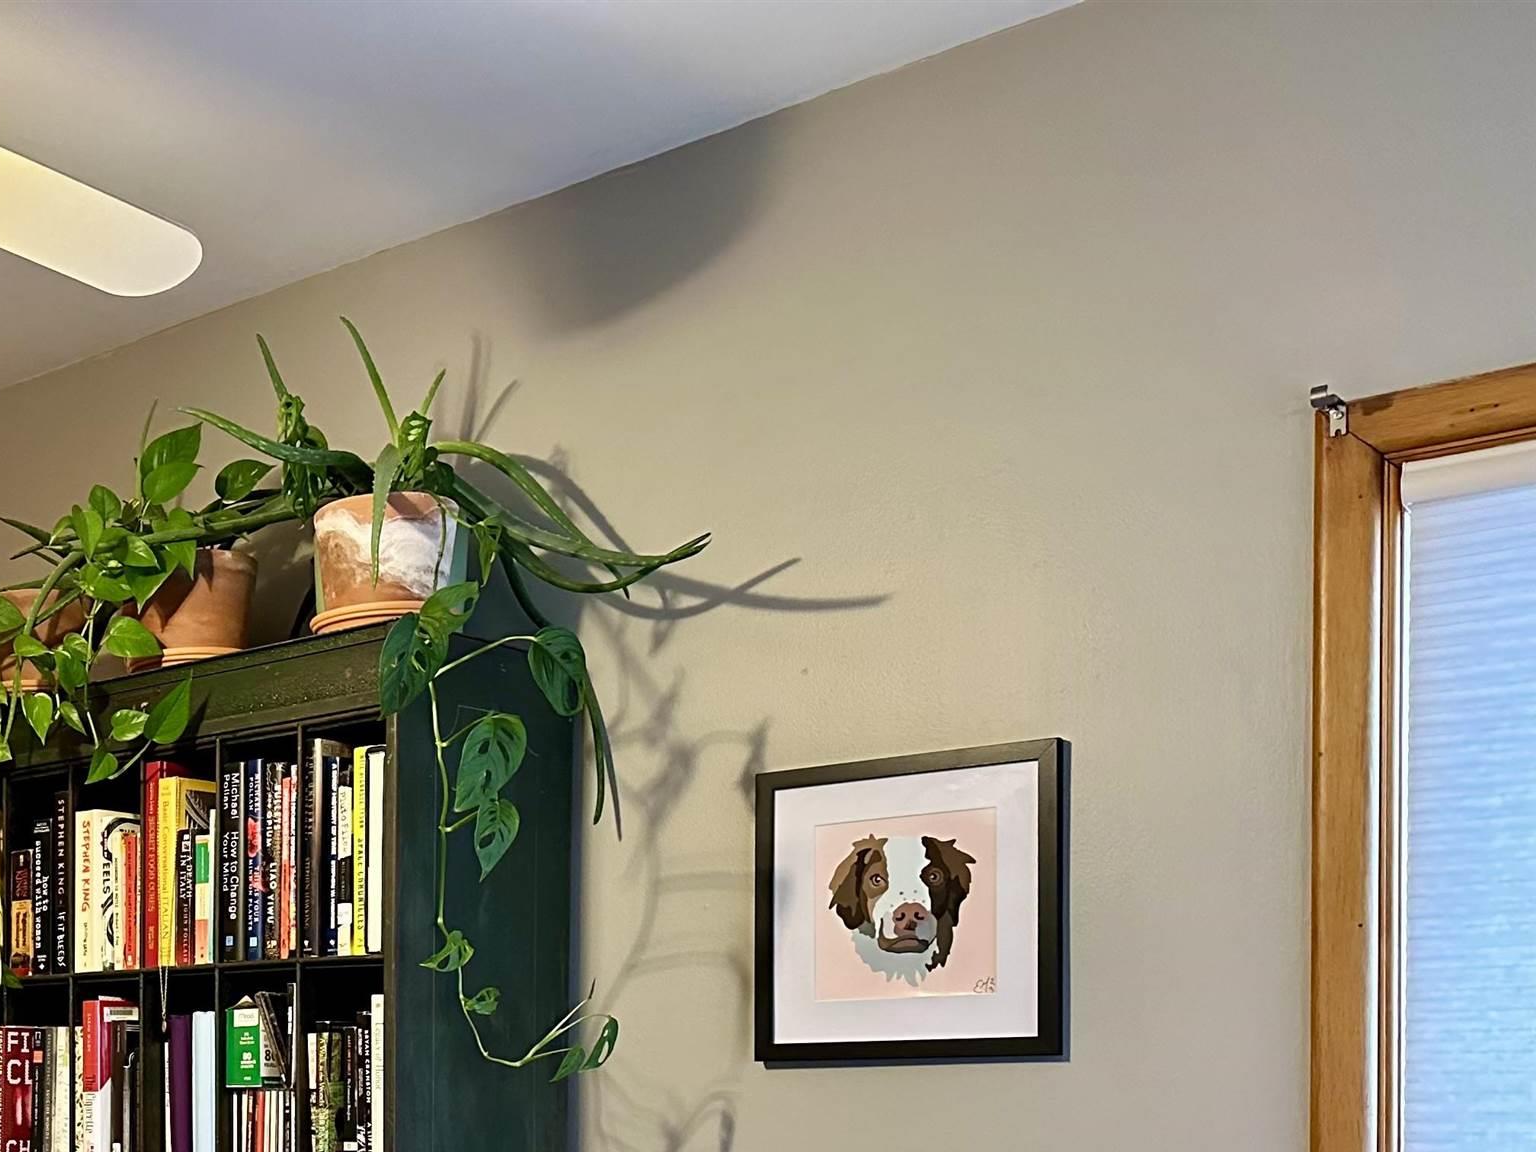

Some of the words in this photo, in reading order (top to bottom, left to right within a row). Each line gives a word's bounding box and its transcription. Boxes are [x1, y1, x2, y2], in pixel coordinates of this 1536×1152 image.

[223, 774, 231, 810] Pollan
[231, 773, 240, 819] Michael
[82, 820, 90, 873] STEPHEN
[230, 831, 239, 858] How
[179, 854, 186, 868] IN
[223, 862, 231, 892] Mind
[231, 861, 239, 872] to
[269, 862, 277, 889] LIAO
[102, 862, 111, 894] EELS
[179, 871, 187, 900] ITALY
[42, 899, 49, 911] to
[81, 878, 90, 912] KING
[228, 875, 239, 920] Change
[161, 895, 169, 939] ITALIAN
[57, 935, 66, 967] BLEEDS
